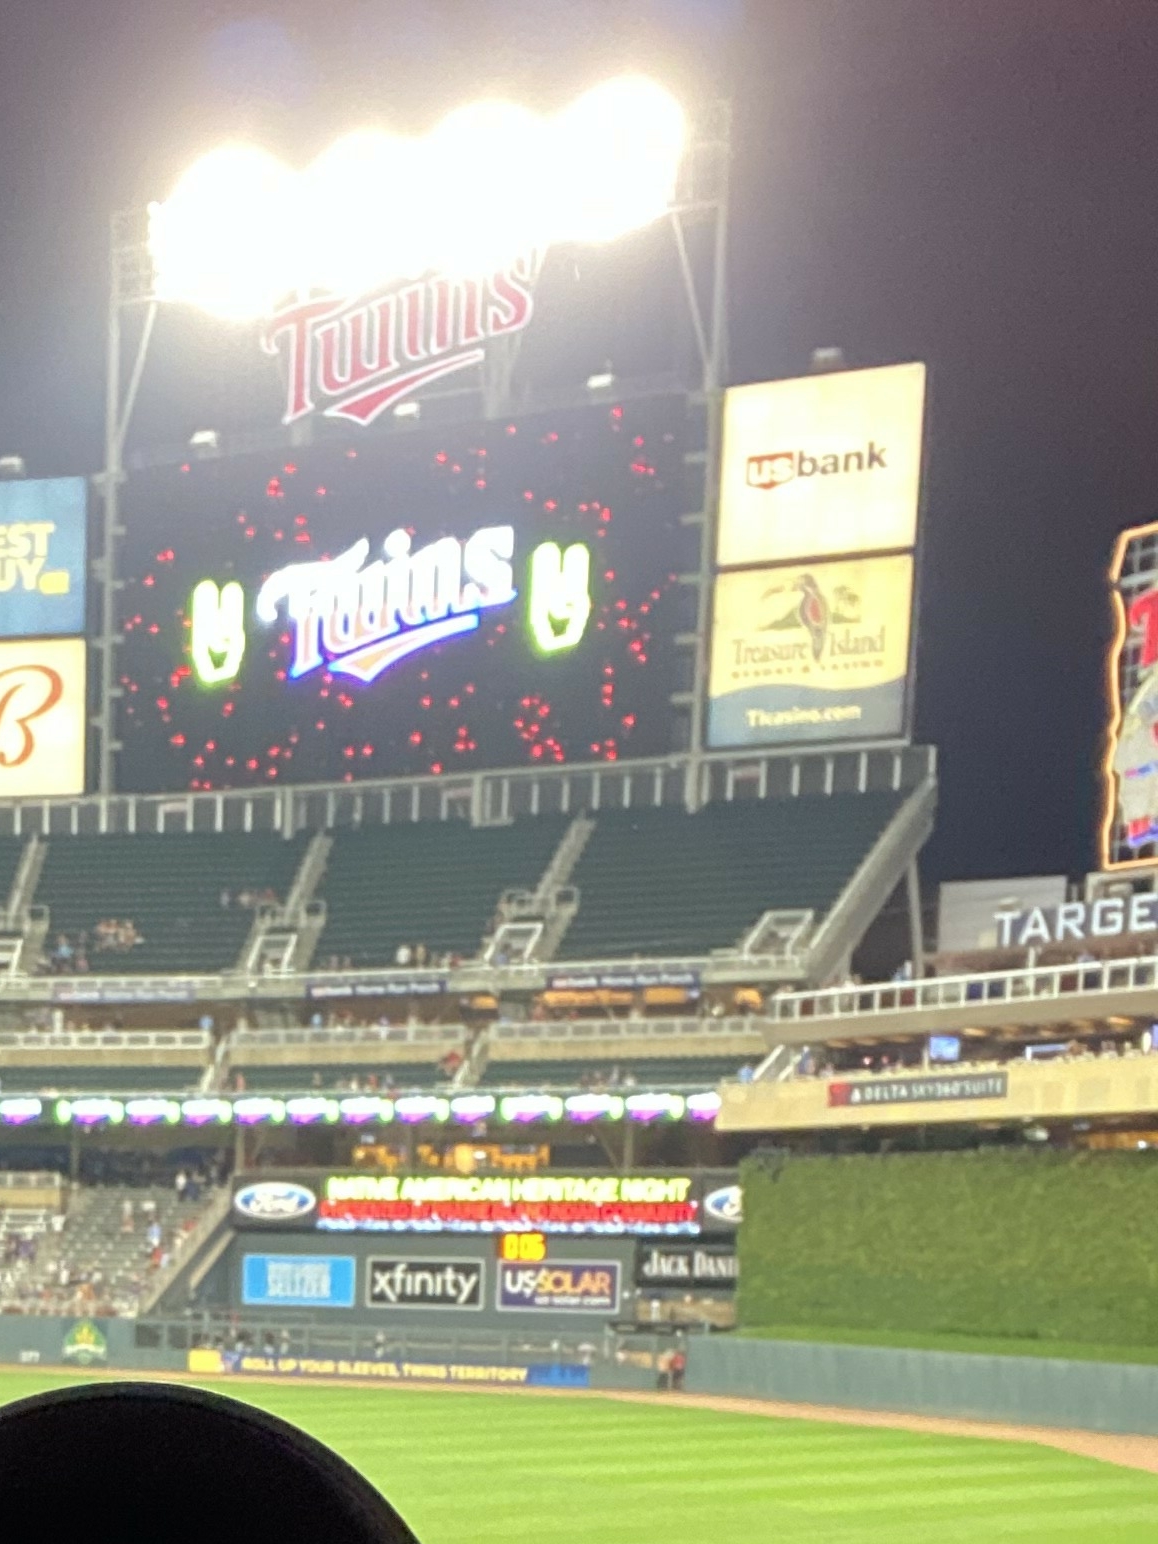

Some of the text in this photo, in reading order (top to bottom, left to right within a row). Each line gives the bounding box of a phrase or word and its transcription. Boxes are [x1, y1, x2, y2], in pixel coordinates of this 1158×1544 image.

[260, 254, 542, 425] Twins
[257, 526, 516, 682] Twins
[732, 626, 886, 667] Treasure Island
[864, 1083, 908, 1101] DELTA
[327, 1177, 399, 1200] NATIVE
[401, 1177, 510, 1201] AMERICAN
[512, 1177, 619, 1202] HERITAGE
[620, 1178, 692, 1202] NIGHT
[643, 1249, 689, 1276] JACK
[373, 1263, 478, 1304] xfinity
[539, 1269, 612, 1295] SOLAR
[242, 1357, 275, 1371] ROLL
[278, 1358, 297, 1372] UP
[299, 1359, 335, 1374] YOUR
[402, 1362, 447, 1379] TWINS
[450, 1364, 528, 1382] TERRITORY
